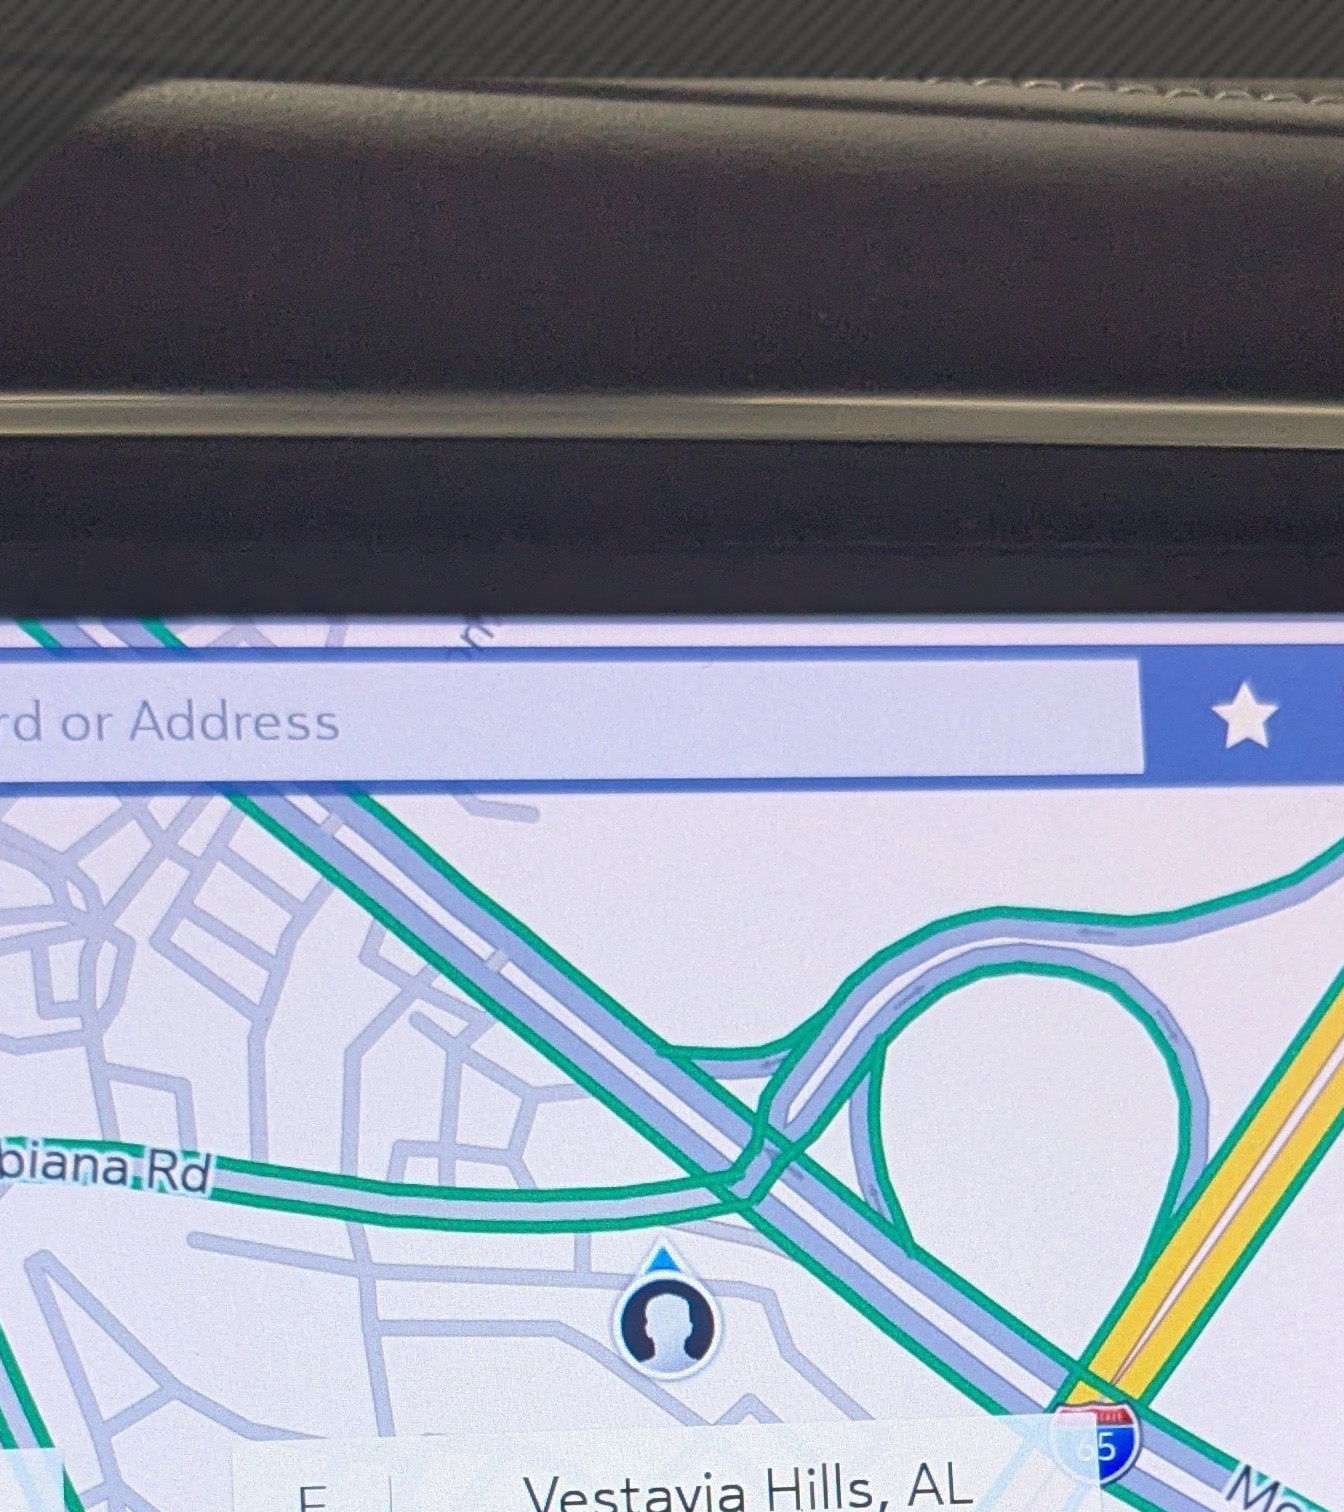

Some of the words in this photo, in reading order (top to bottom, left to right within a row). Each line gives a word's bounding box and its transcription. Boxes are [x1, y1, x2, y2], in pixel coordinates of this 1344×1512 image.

[60, 710, 113, 743] or
[129, 698, 340, 742] Address
[146, 1148, 213, 1195] Rd
[906, 1460, 975, 1507] AL
